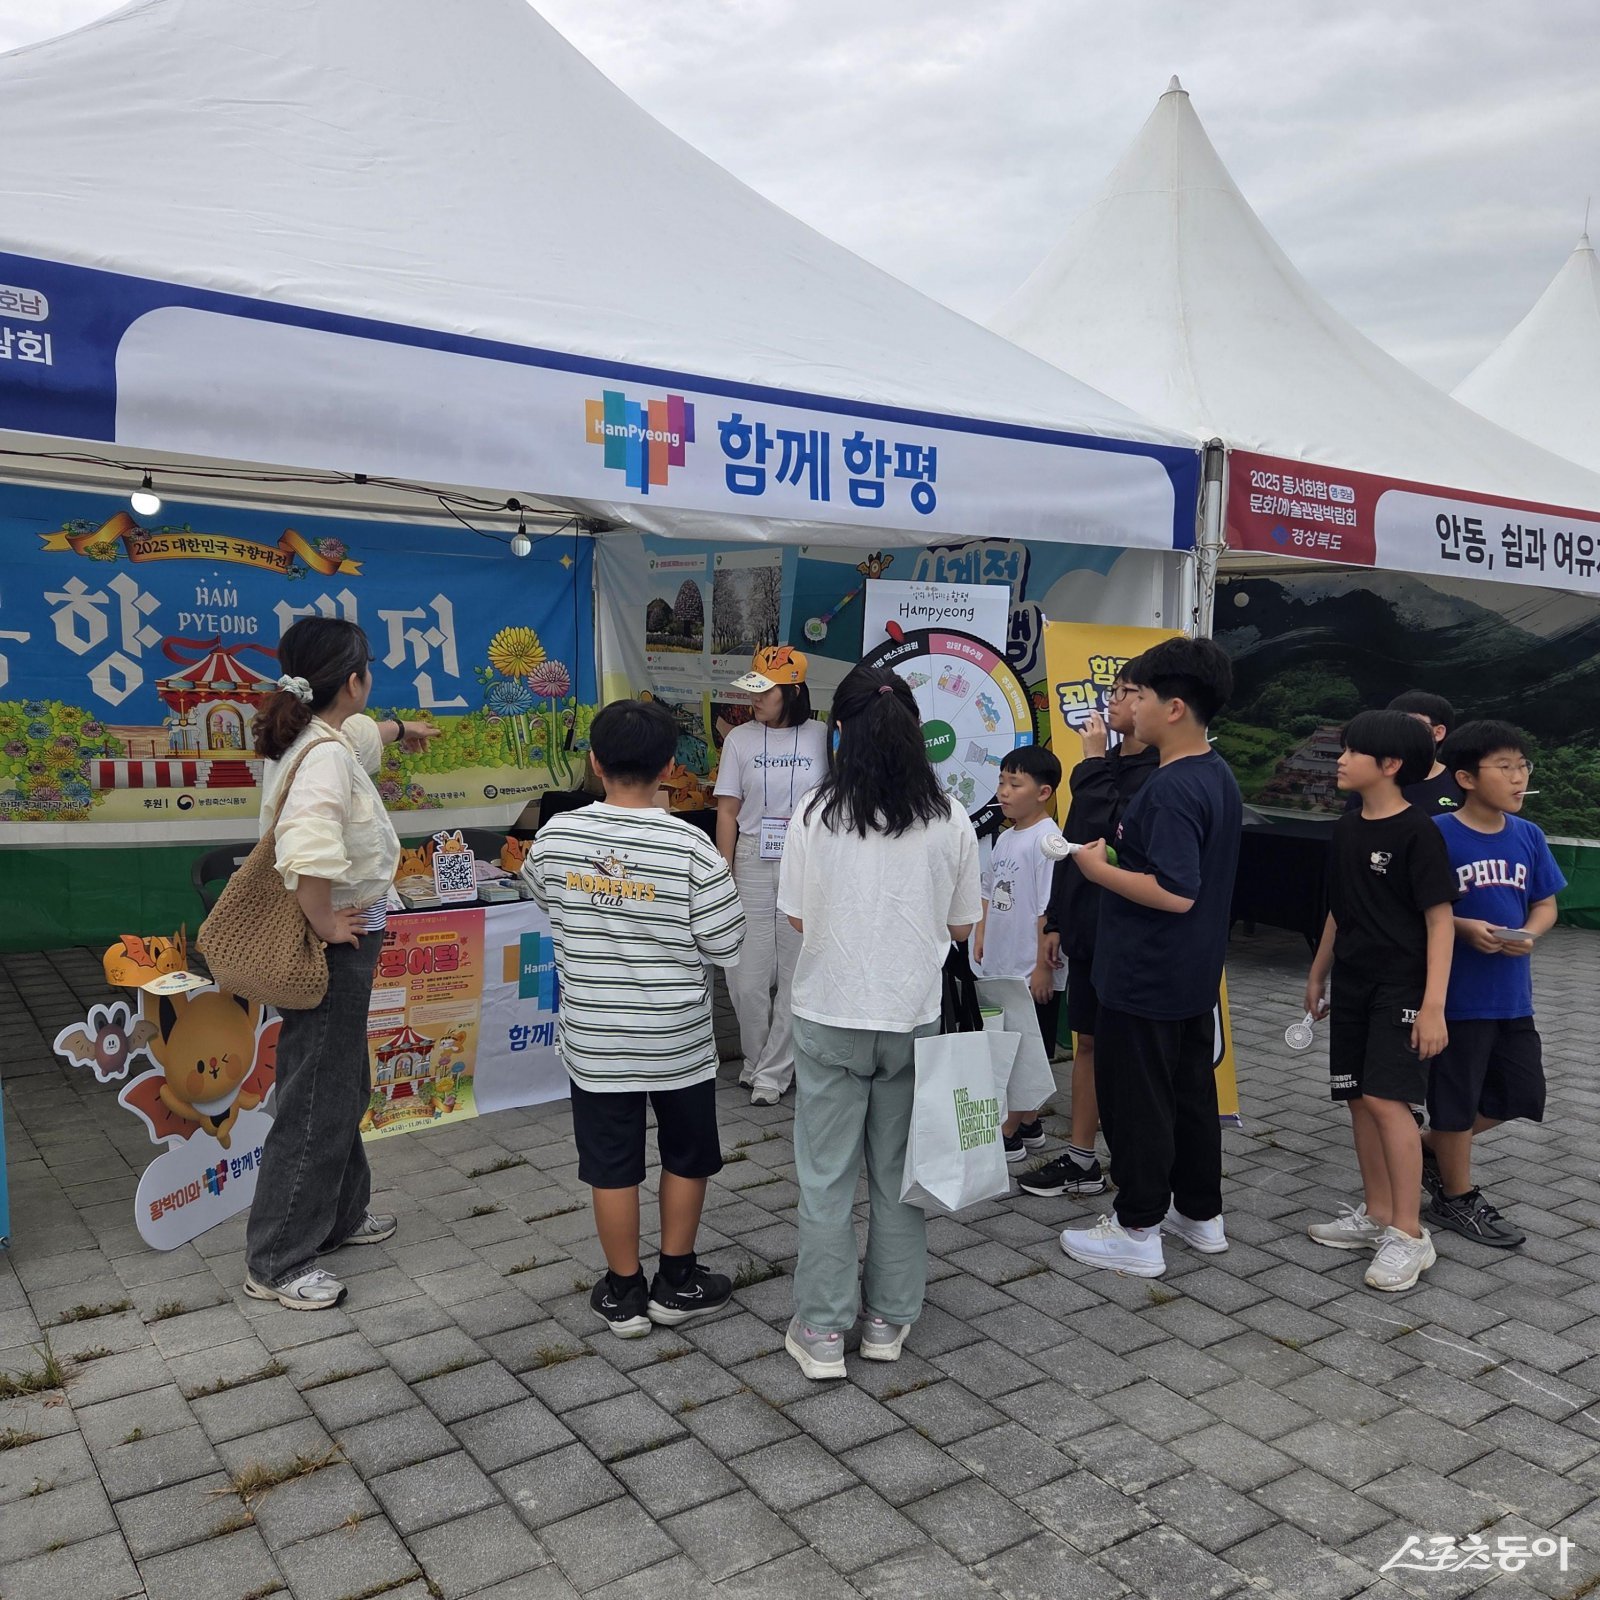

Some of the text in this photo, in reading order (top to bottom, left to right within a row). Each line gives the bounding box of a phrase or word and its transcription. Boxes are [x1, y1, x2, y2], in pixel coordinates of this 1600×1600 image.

[594, 418, 680, 447] HamPyeong
[717, 412, 937, 515] 함께 함평
[1250, 470, 1280, 492] 2025
[1282, 475, 1328, 500] 동서화합
[1250, 493, 1357, 527] 문화예술관광박람회
[133, 538, 287, 569] 2025 대한민국 국향대전
[1292, 528, 1342, 550] 경상북도
[1435, 513, 1600, 578] 안동, 쉼과 여유
[195, 586, 238, 607] HAM
[178, 612, 258, 634] PYEONG
[899, 602, 975, 622] Hampyeong
[753, 755, 813, 771] Scenery
[143, 799, 163, 809] 후원
[565, 871, 656, 902] MOMENTS
[591, 891, 623, 906] Club
[509, 1021, 555, 1052] 함께
[149, 1180, 201, 1222] 황박이와
[230, 1151, 254, 1179] 함께
